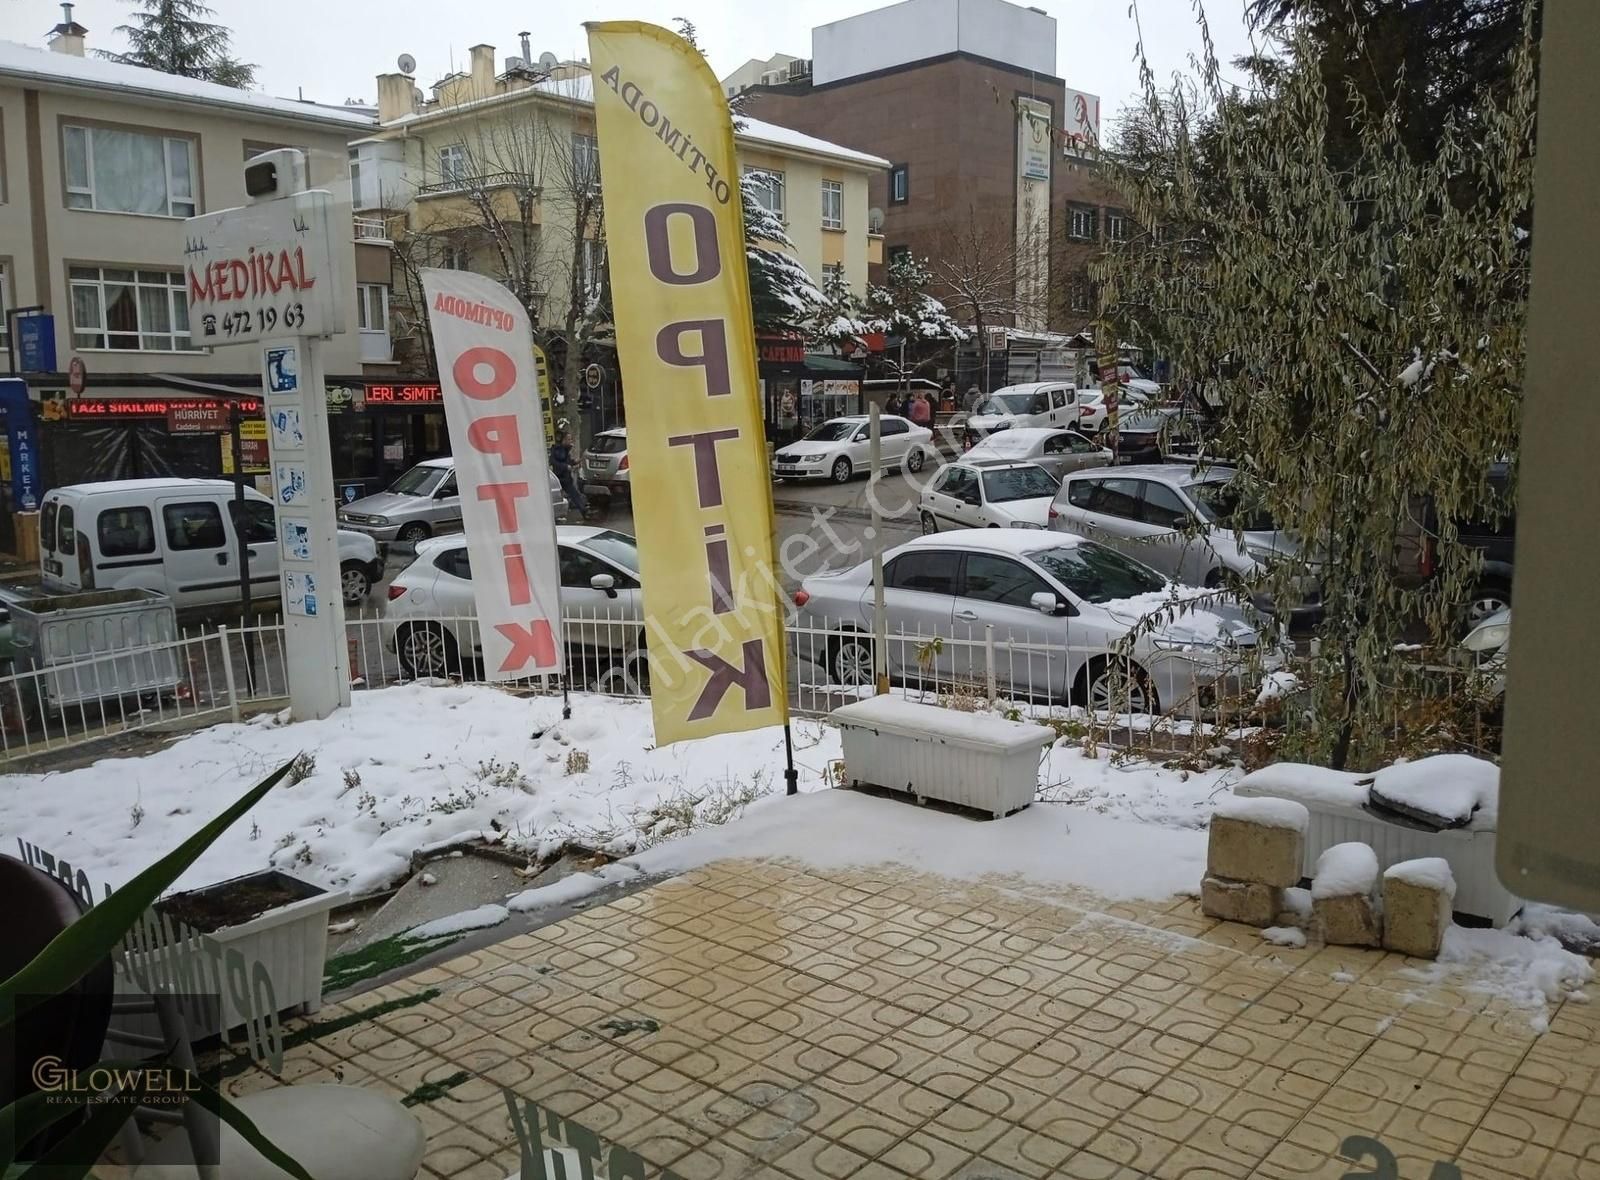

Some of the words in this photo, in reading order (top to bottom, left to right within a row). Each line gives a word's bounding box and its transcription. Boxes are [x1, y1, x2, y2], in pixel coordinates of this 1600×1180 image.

[188, 246, 316, 309] MEDİKAL
[222, 310, 252, 337] 472
[257, 306, 278, 333] 19
[284, 302, 305, 329] 63
[174, 409, 218, 419] HÜRRİYET
[17, 431, 31, 494] MARKET
